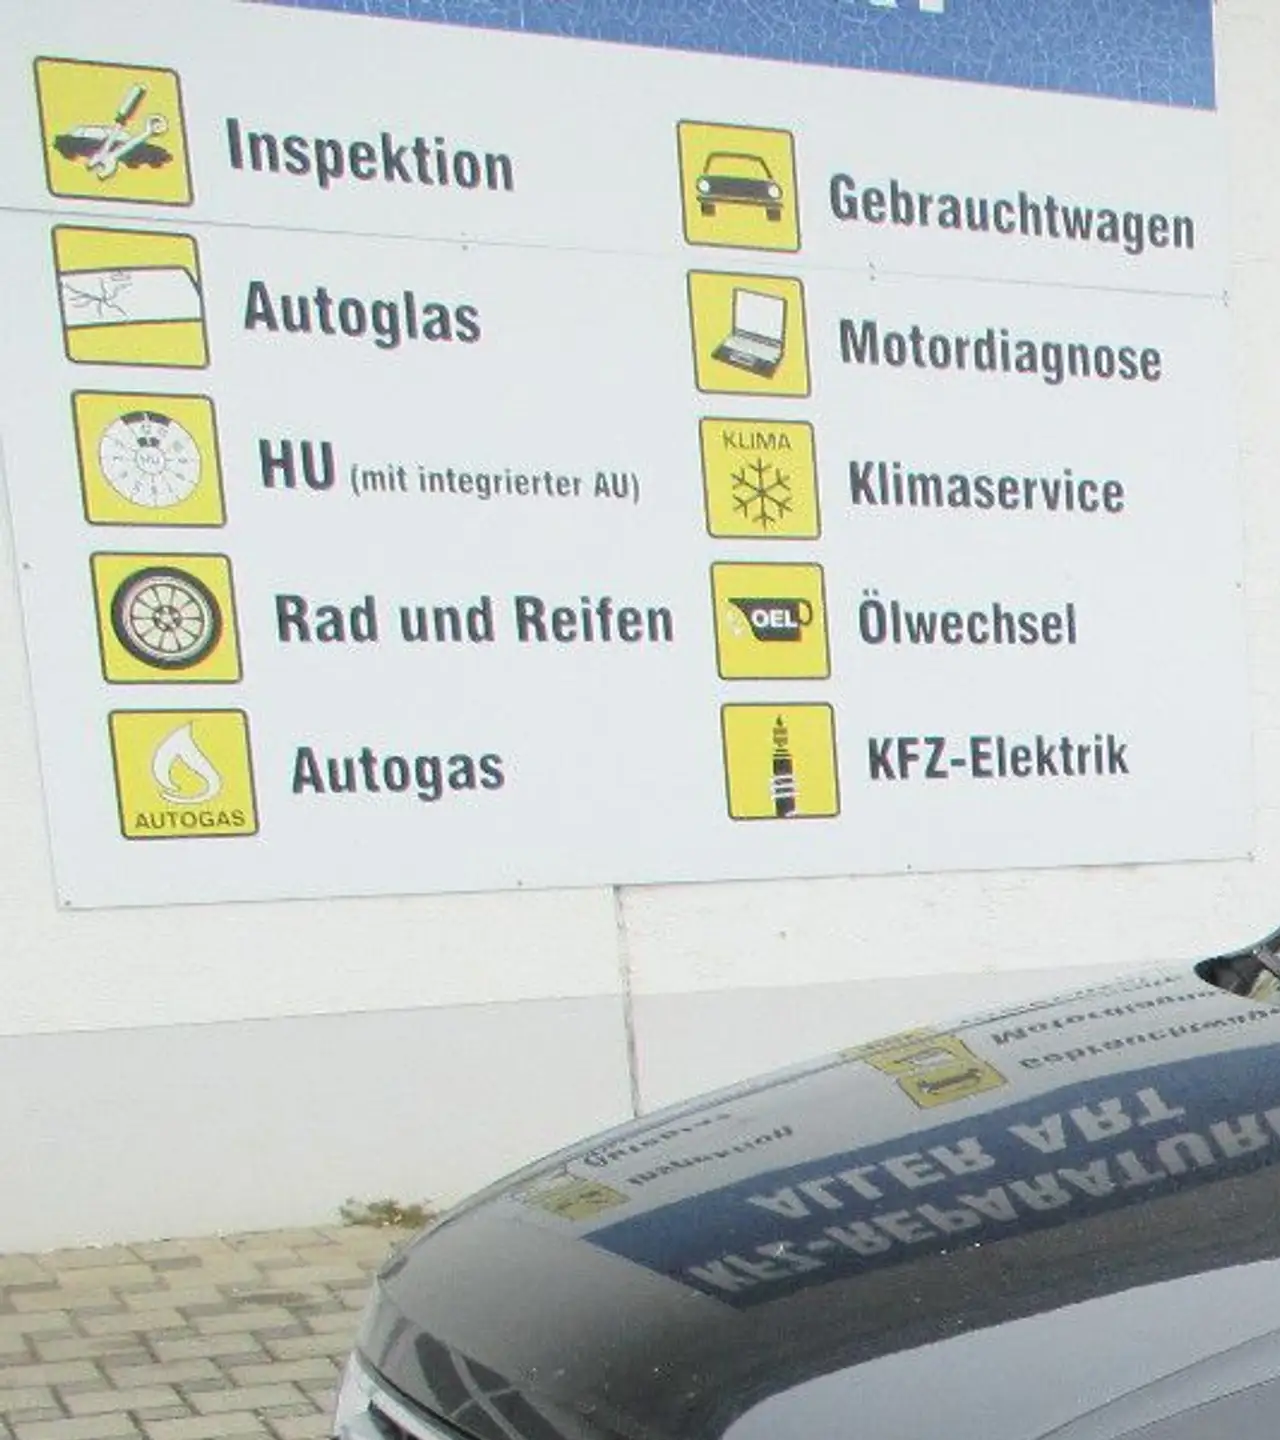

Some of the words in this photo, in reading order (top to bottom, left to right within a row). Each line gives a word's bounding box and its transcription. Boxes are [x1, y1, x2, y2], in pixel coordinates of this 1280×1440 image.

[226, 117, 516, 191] Inspektion
[829, 173, 1195, 255] Gebrauchtwagen
[244, 280, 483, 349] Autoglas
[839, 319, 1163, 385] Motordiagnose
[722, 429, 793, 453] KLIMA
[259, 437, 335, 491] HU
[350, 463, 409, 498] (mit
[419, 463, 582, 502] integrierter
[593, 474, 640, 504] AU)
[849, 461, 1126, 514] Klimaservice
[275, 594, 378, 643] Rad
[402, 594, 494, 643] und
[515, 596, 674, 643] Reifen
[752, 608, 798, 631] OEL
[858, 589, 1077, 646] Ölwechsel
[292, 745, 505, 802] Autogas
[867, 735, 1130, 780] KFZ-Elektrik
[134, 810, 246, 831] AUTOGAS
